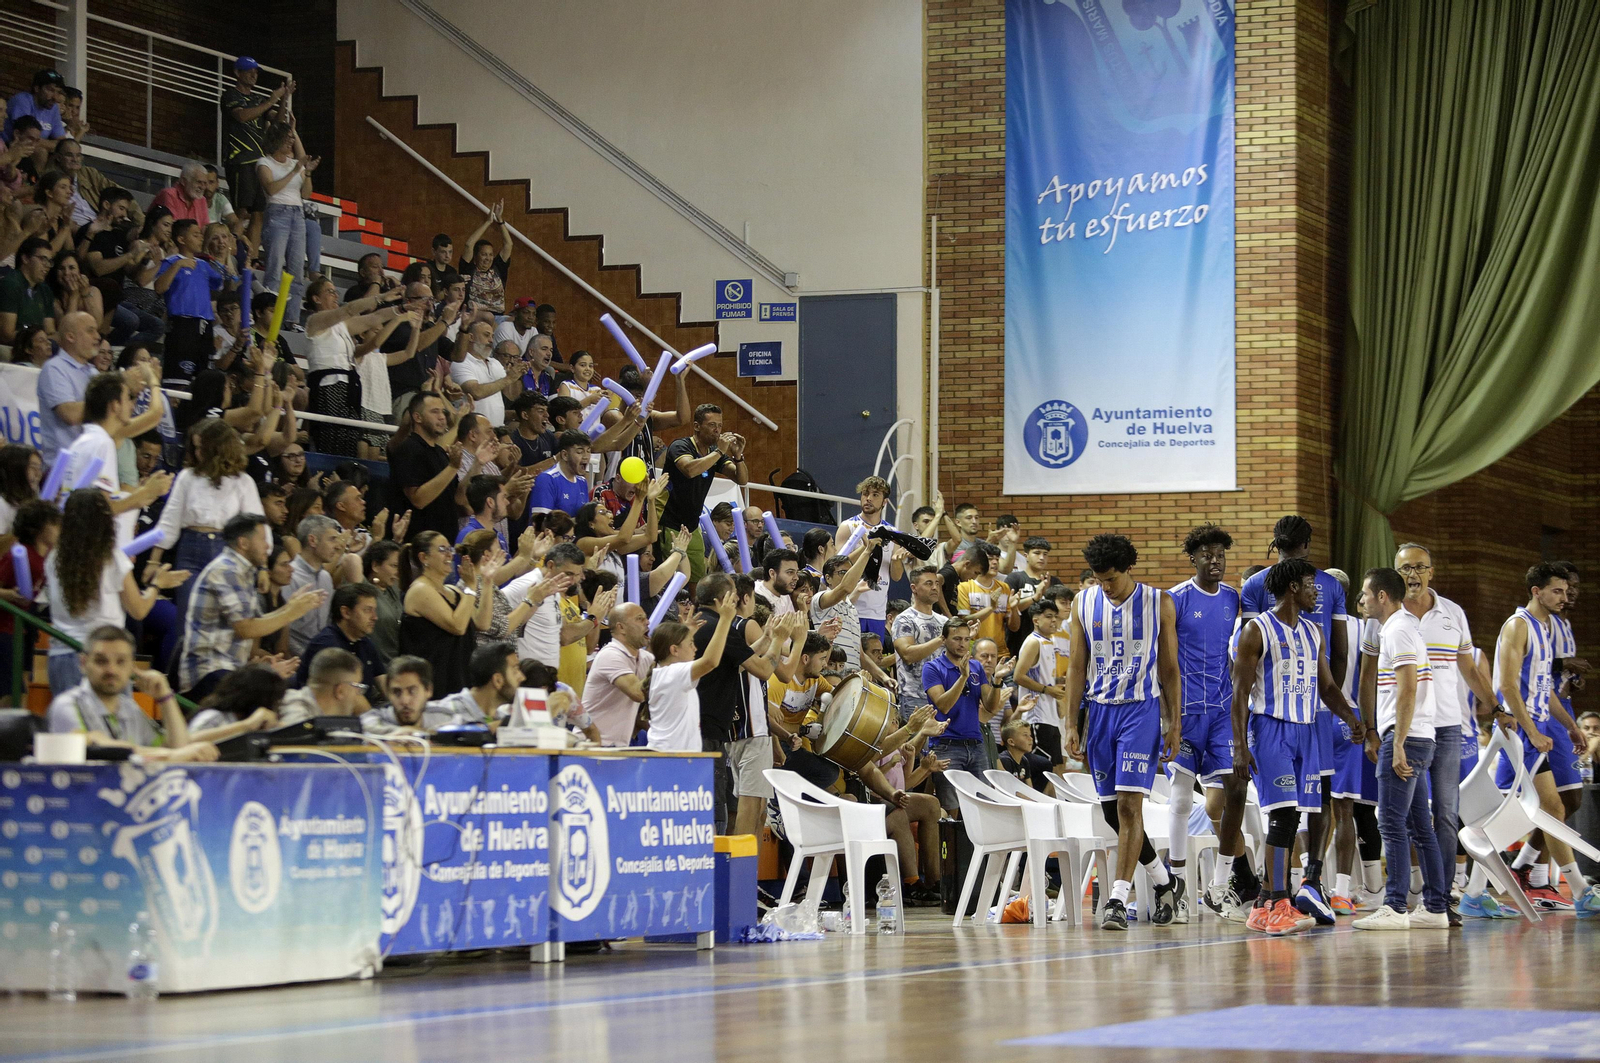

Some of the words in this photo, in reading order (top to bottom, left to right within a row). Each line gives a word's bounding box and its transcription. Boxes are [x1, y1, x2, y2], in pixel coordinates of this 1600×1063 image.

[1037, 164, 1208, 221] Apoyamos
[1038, 217, 1076, 245] tu
[1084, 203, 1210, 254] esfuerzo
[716, 302, 752, 310] PROHIBIDO
[748, 358, 773, 366] TÉCNICA
[1091, 406, 1213, 423] Ayuntamiento
[1126, 423, 1147, 435] de
[1152, 422, 1213, 435] Huelva
[1169, 438, 1216, 448] Deportes
[1111, 640, 1125, 657] 13
[1296, 659, 1305, 676] 9
[424, 784, 548, 822] Ayuntamiento
[606, 784, 713, 820] Ayuntamiento
[460, 821, 484, 852] de
[487, 820, 549, 851] Huelva
[640, 819, 659, 847] de
[661, 818, 713, 846] Huelva
[488, 861, 503, 879] de
[504, 860, 552, 882] Deportes
[664, 855, 677, 873] de
[677, 854, 715, 874] Deportes
